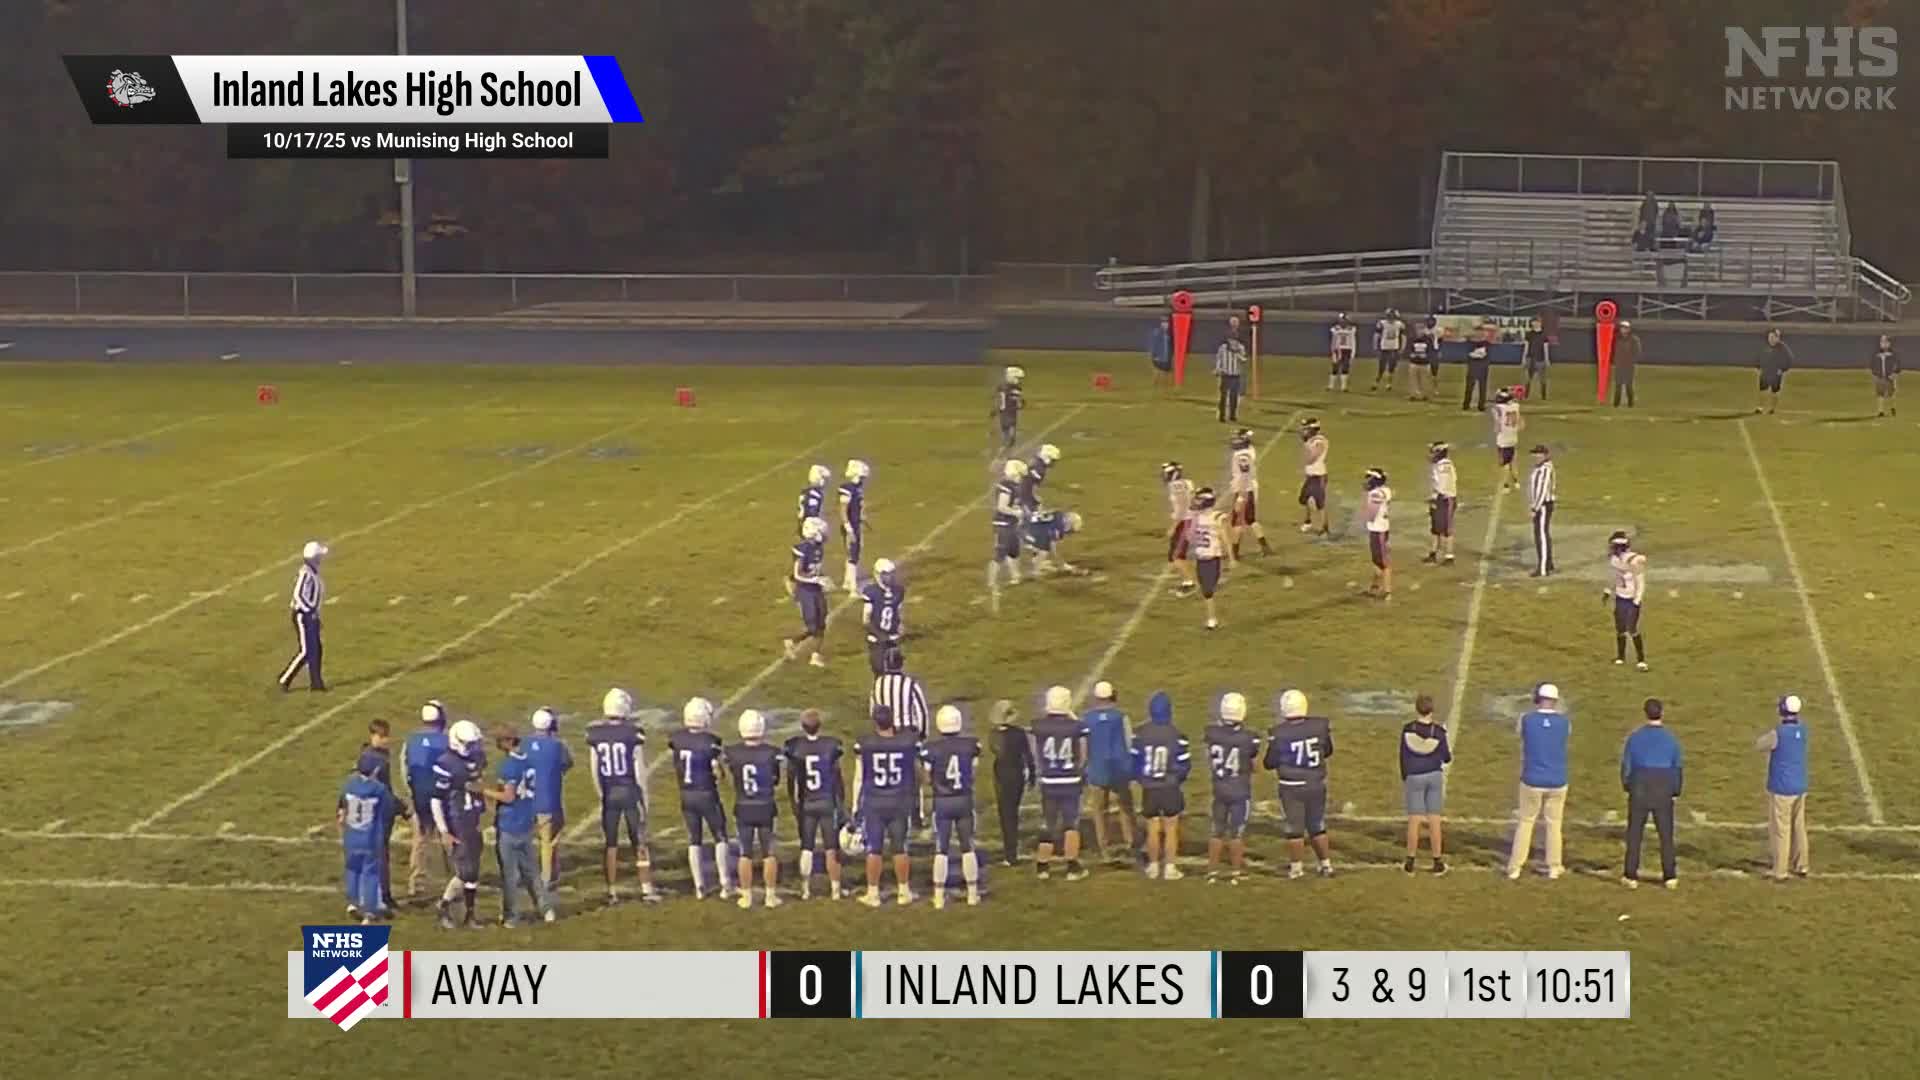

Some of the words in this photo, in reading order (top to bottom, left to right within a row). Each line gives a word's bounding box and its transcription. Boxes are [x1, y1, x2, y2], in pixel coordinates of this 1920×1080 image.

[880, 607, 894, 631] 8
[597, 741, 629, 777] 30
[679, 749, 693, 784] 7
[872, 752, 904, 787] 55
[1043, 735, 1075, 770] 44
[1143, 745, 1169, 778] 10
[1209, 745, 1240, 777] 24
[1290, 737, 1320, 767] 75
[742, 763, 759, 795] 6
[805, 754, 822, 791] 5
[945, 754, 963, 790] 4
